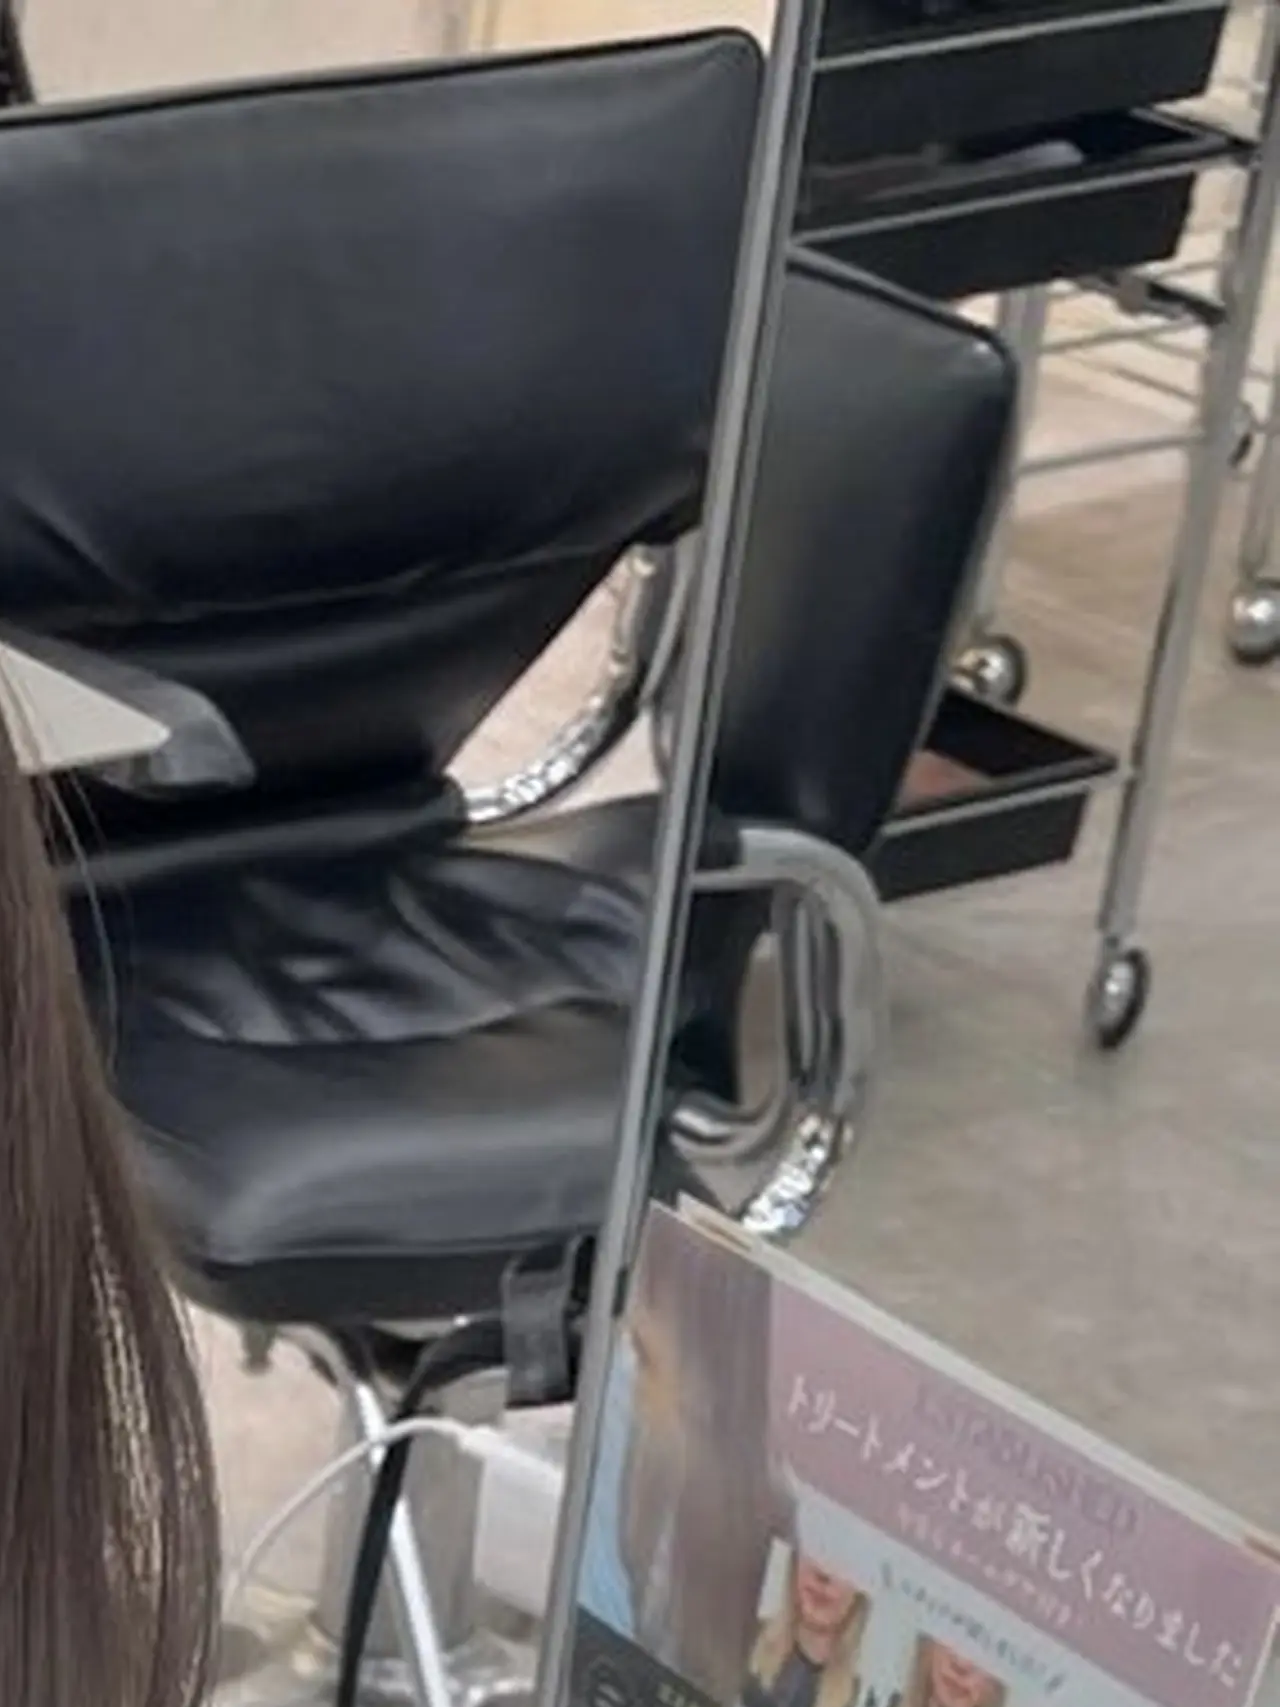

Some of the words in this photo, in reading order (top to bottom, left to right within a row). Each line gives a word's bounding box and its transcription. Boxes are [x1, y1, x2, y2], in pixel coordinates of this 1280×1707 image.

[788, 1374, 1241, 1688] トリートメントが新しくなりました
